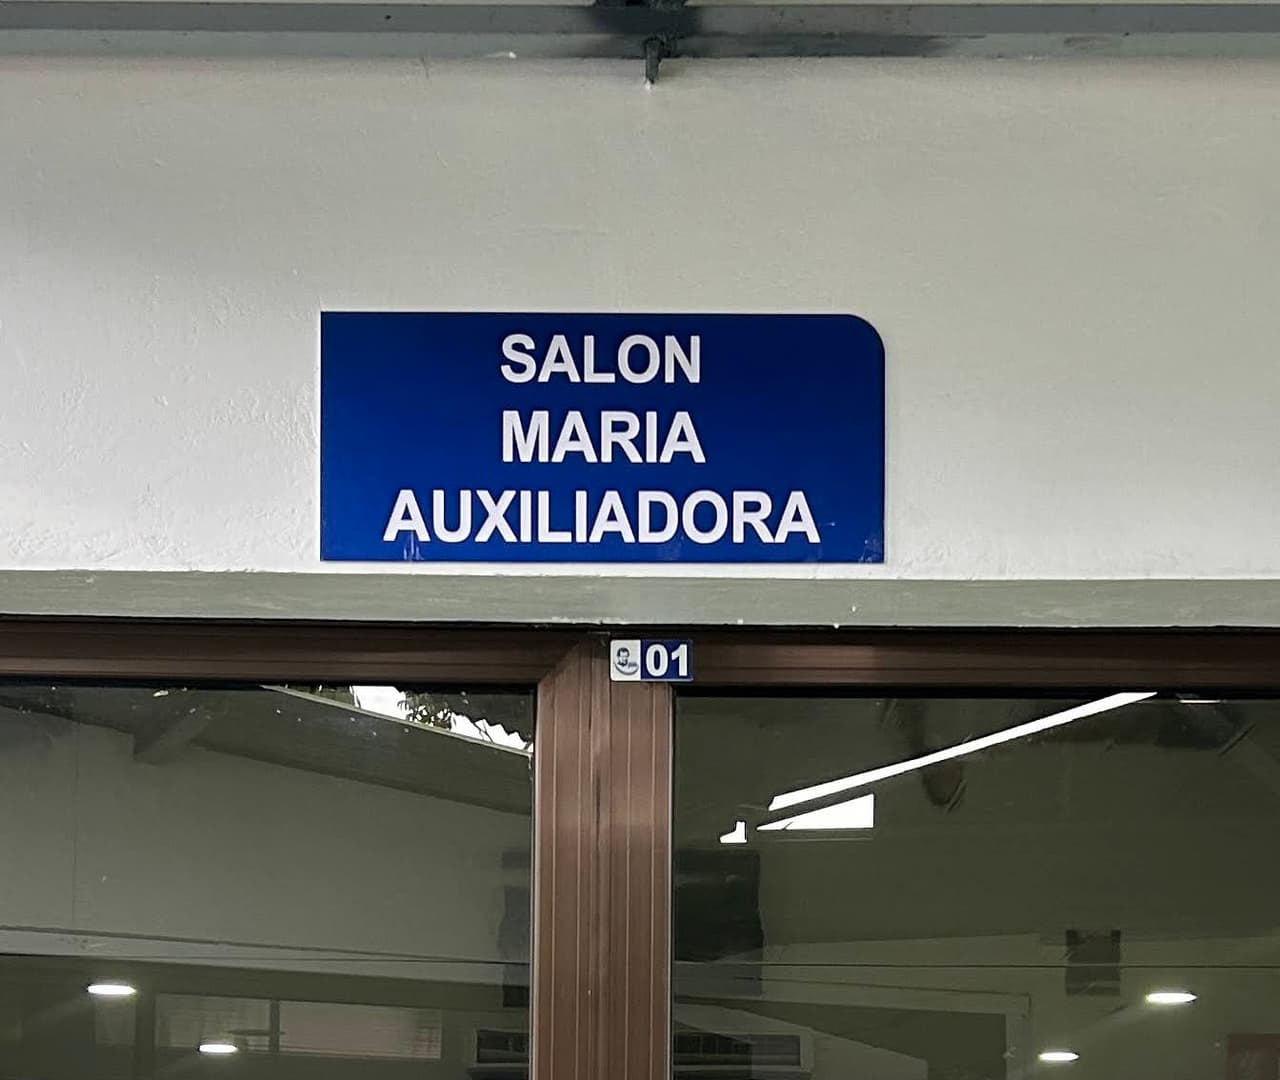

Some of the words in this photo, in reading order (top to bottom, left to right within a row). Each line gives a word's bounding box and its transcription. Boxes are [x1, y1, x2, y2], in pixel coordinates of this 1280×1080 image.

[500, 333, 701, 384] SALON
[502, 410, 706, 463] MARIA
[383, 489, 821, 544] AUXILIADORA
[645, 644, 688, 677] 01
